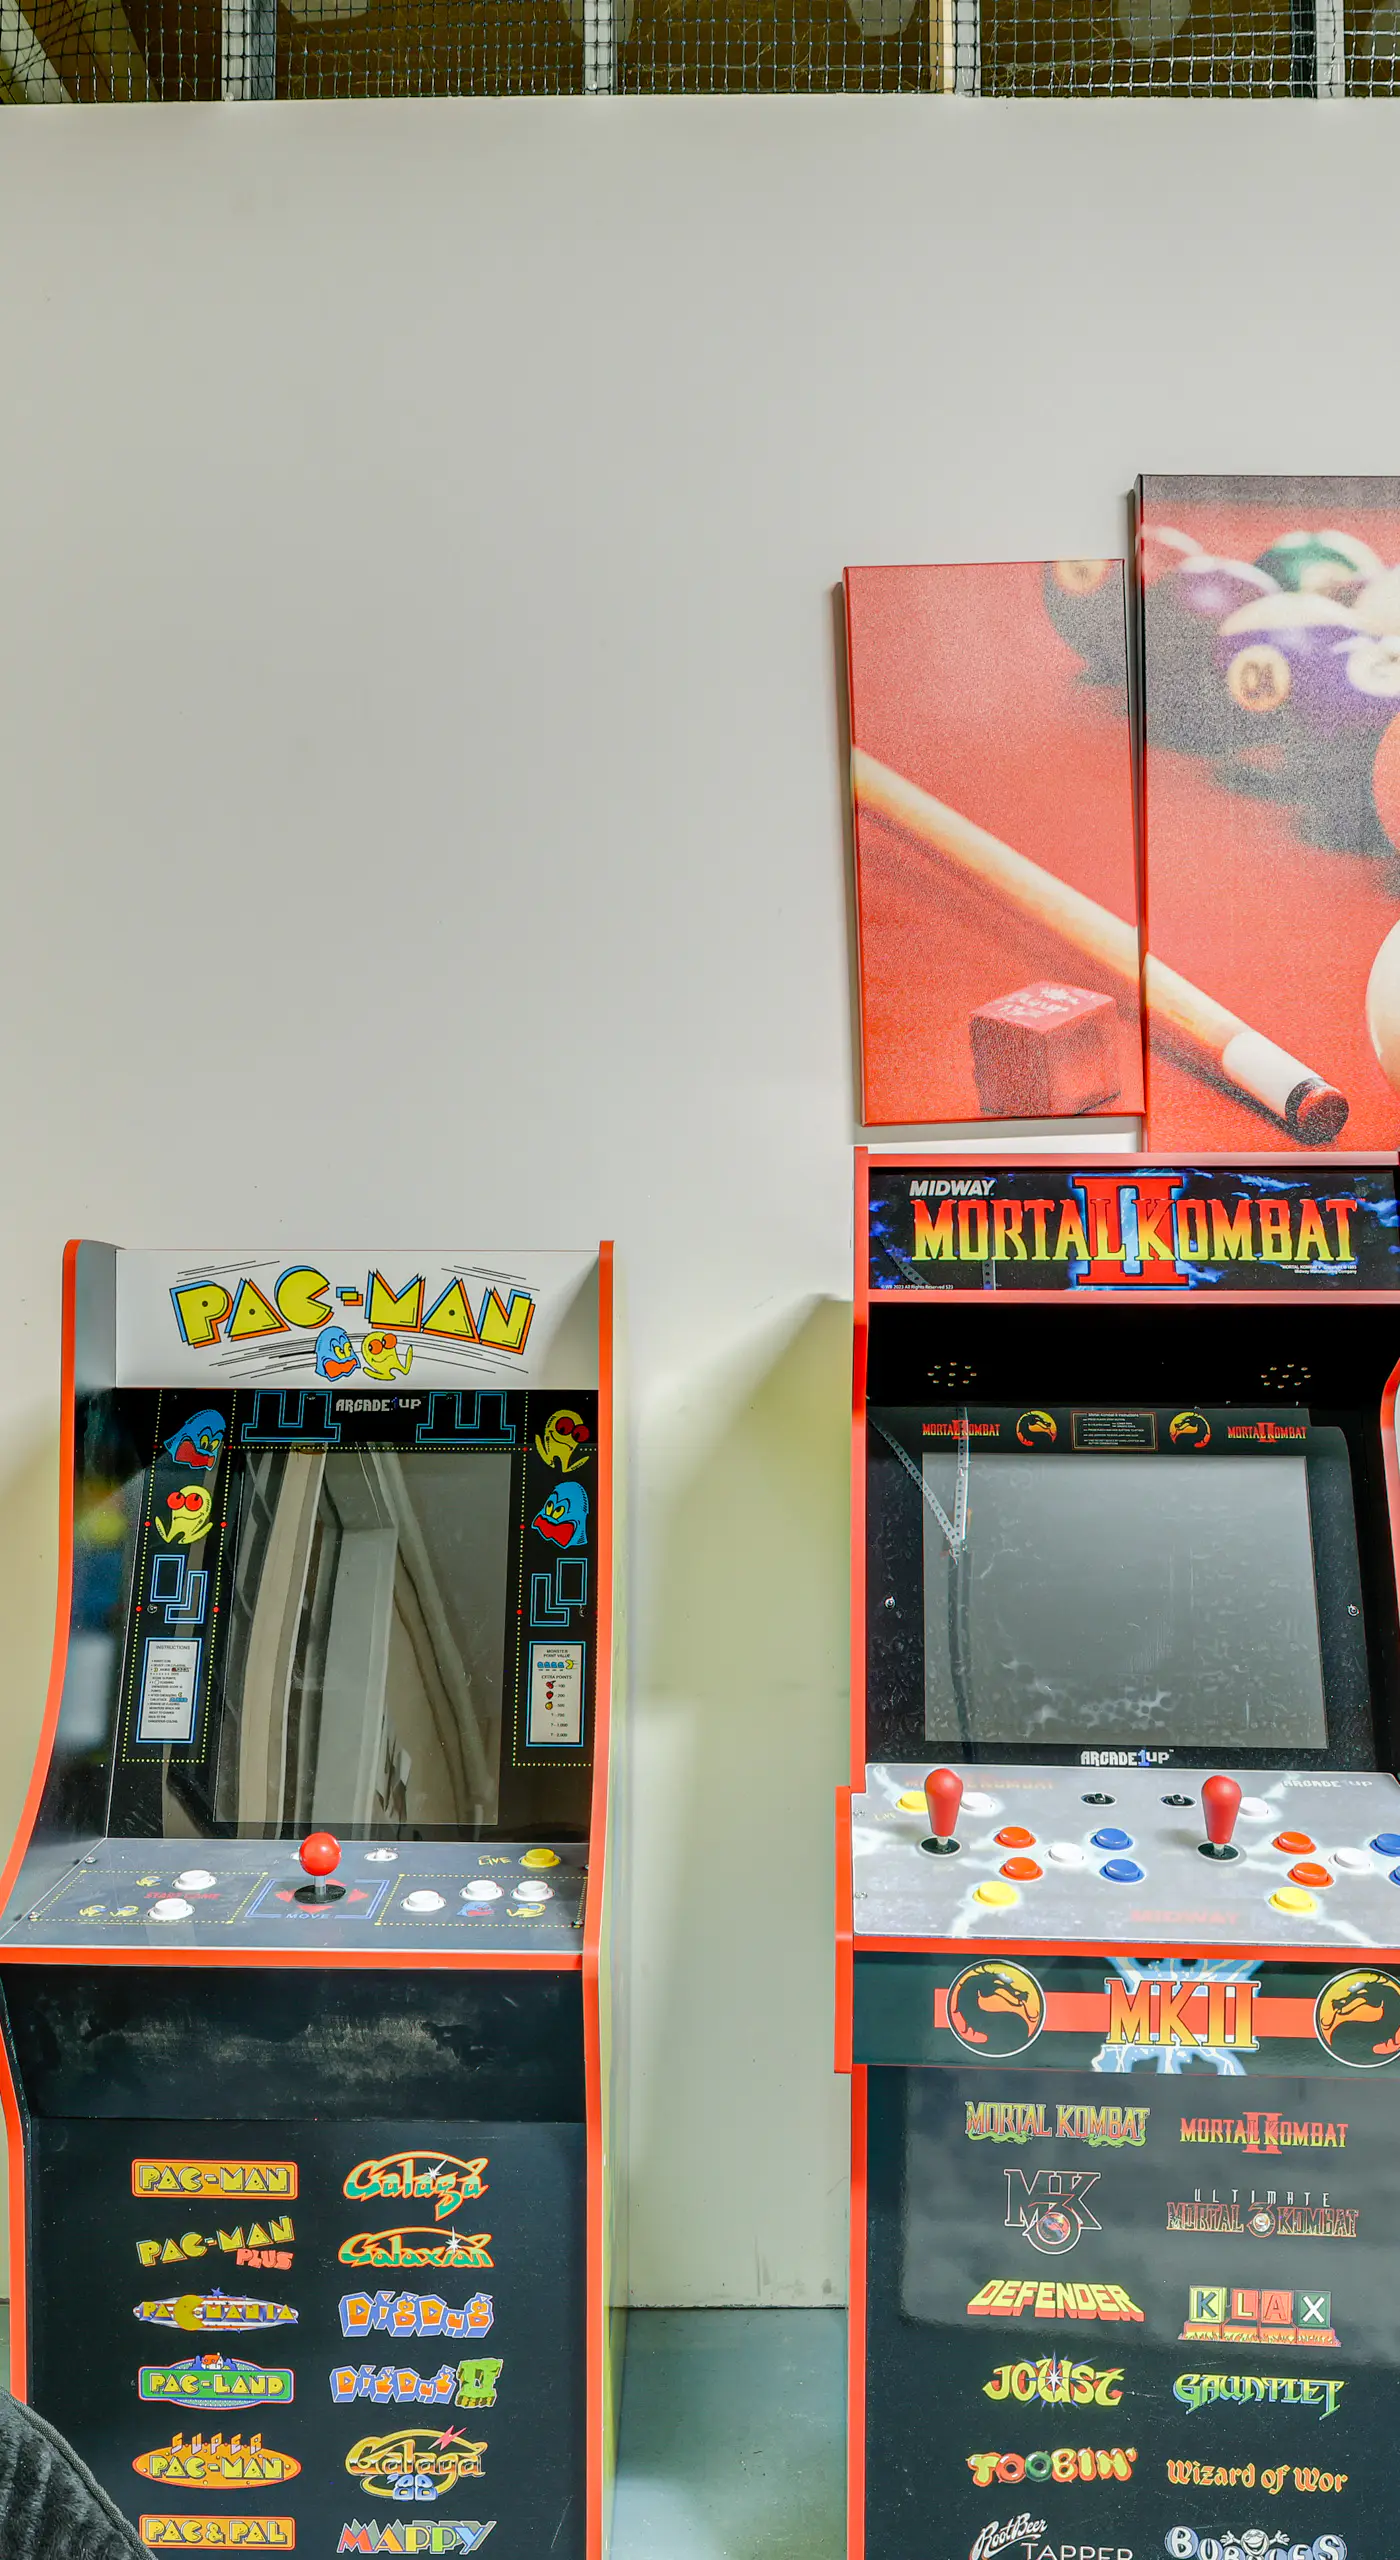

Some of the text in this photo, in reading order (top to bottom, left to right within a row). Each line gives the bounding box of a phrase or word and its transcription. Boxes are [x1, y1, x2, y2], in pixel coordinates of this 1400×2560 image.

[910, 1176, 1358, 1285] MORTAL II KOMBAT
[169, 1265, 536, 1354] PAC-MAN
[922, 1423, 961, 1436] MORTAL
[962, 1423, 1001, 1437] KOMBAT
[1227, 1425, 1267, 1439] MORTAL
[1267, 1425, 1308, 1439] KOMBAT
[1080, 1748, 1170, 1767] ARCADE1UP
[965, 2101, 1150, 2142] MORTAL KOMBAT
[1180, 2117, 1262, 2145] MORTAL
[1261, 2121, 1349, 2149] KOMBAT
[138, 2165, 291, 2194] PAC-MAN
[342, 2150, 491, 2221] Galaga
[1194, 2187, 1330, 2208] ULTIMATE
[1166, 2202, 1244, 2233] MORTAL
[1277, 2206, 1359, 2238] KOMBAT
[136, 2214, 296, 2267] PAC-MAN
[338, 2226, 496, 2268] Galaxian
[235, 2248, 294, 2271] PLUS
[966, 2278, 1145, 2322] DEFENDER
[1194, 2287, 1328, 2325] KLAX
[147, 2373, 287, 2397] PAC-LAND
[982, 2356, 1125, 2406] JOUST
[1172, 2371, 1345, 2420] GAUNTLET
[170, 2431, 264, 2454] SUPER
[345, 2428, 489, 2488] Galaga
[148, 2455, 287, 2480] PAC-MAN
[1166, 2458, 1349, 2495] Wizard of Wor
[336, 2518, 498, 2555] MAPPY
